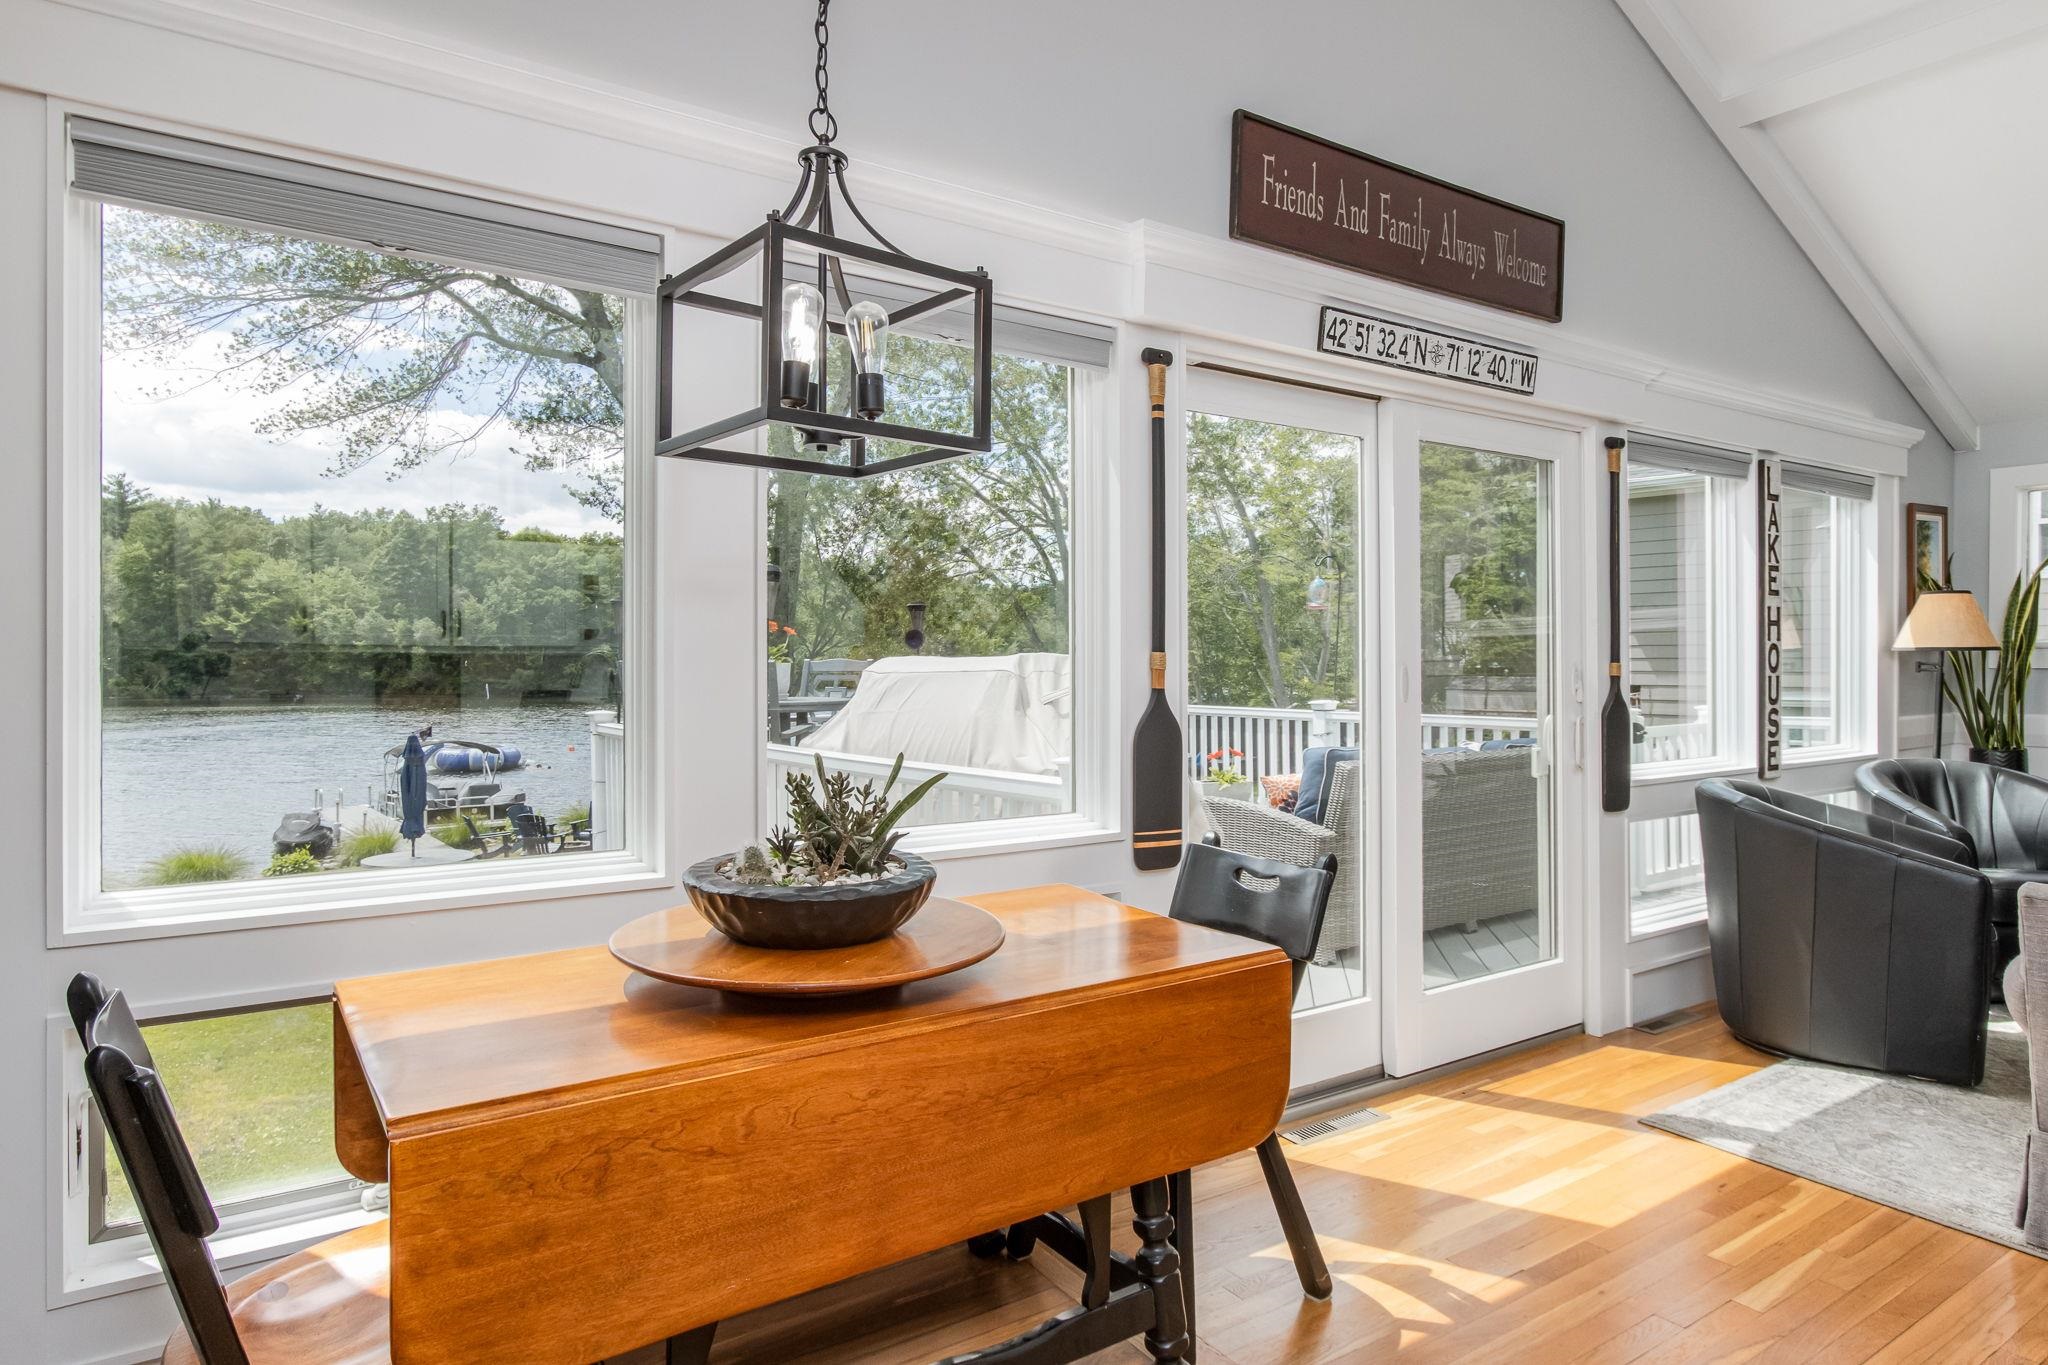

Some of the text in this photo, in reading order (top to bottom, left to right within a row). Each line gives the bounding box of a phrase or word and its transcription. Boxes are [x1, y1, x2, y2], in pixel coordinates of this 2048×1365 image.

[1261, 153, 1547, 287] Friends And Family Always Welcome
[1766, 465, 1781, 771] LAKE HOUSE
